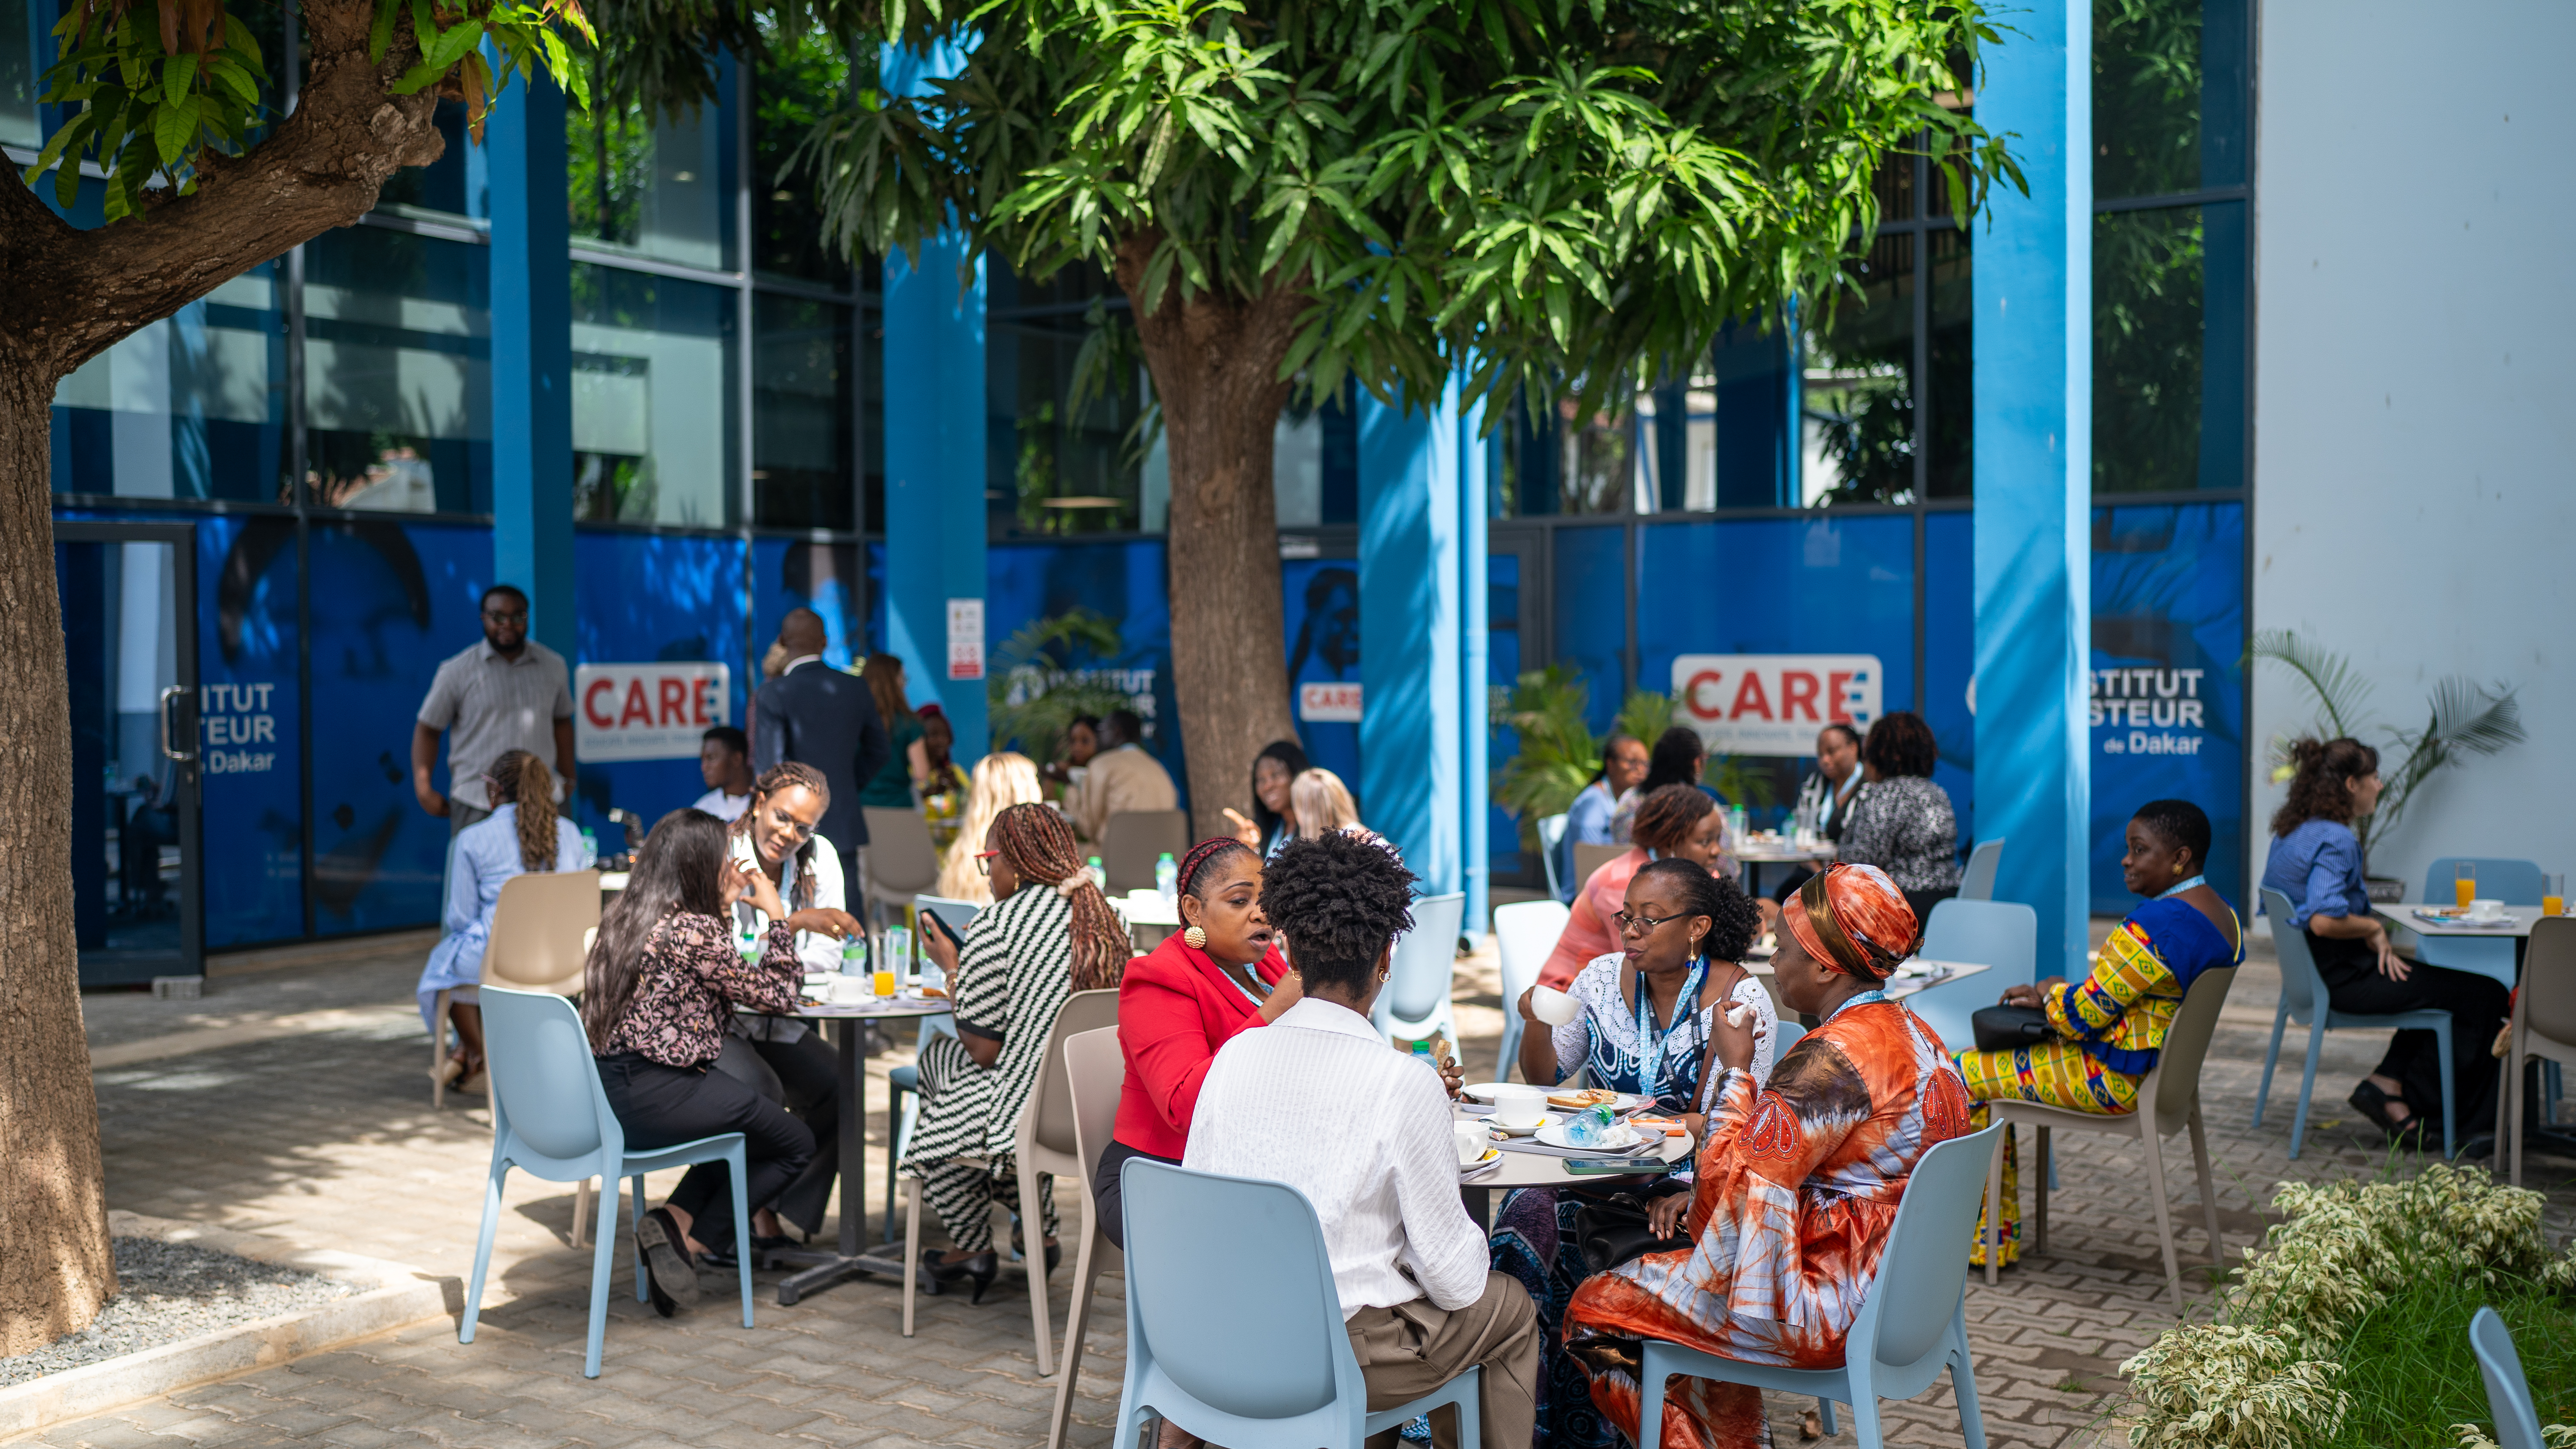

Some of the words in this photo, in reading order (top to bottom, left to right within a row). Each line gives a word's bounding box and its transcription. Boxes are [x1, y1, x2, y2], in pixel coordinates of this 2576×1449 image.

[200, 682, 274, 713] ITUT
[584, 676, 720, 731] CARE
[1685, 668, 1868, 723] CARE
[2090, 697, 2205, 728] STEUR
[200, 714, 276, 746] EUR
[2103, 736, 2125, 754] de
[2128, 730, 2203, 755] Dakar
[209, 749, 276, 774] Dakar
